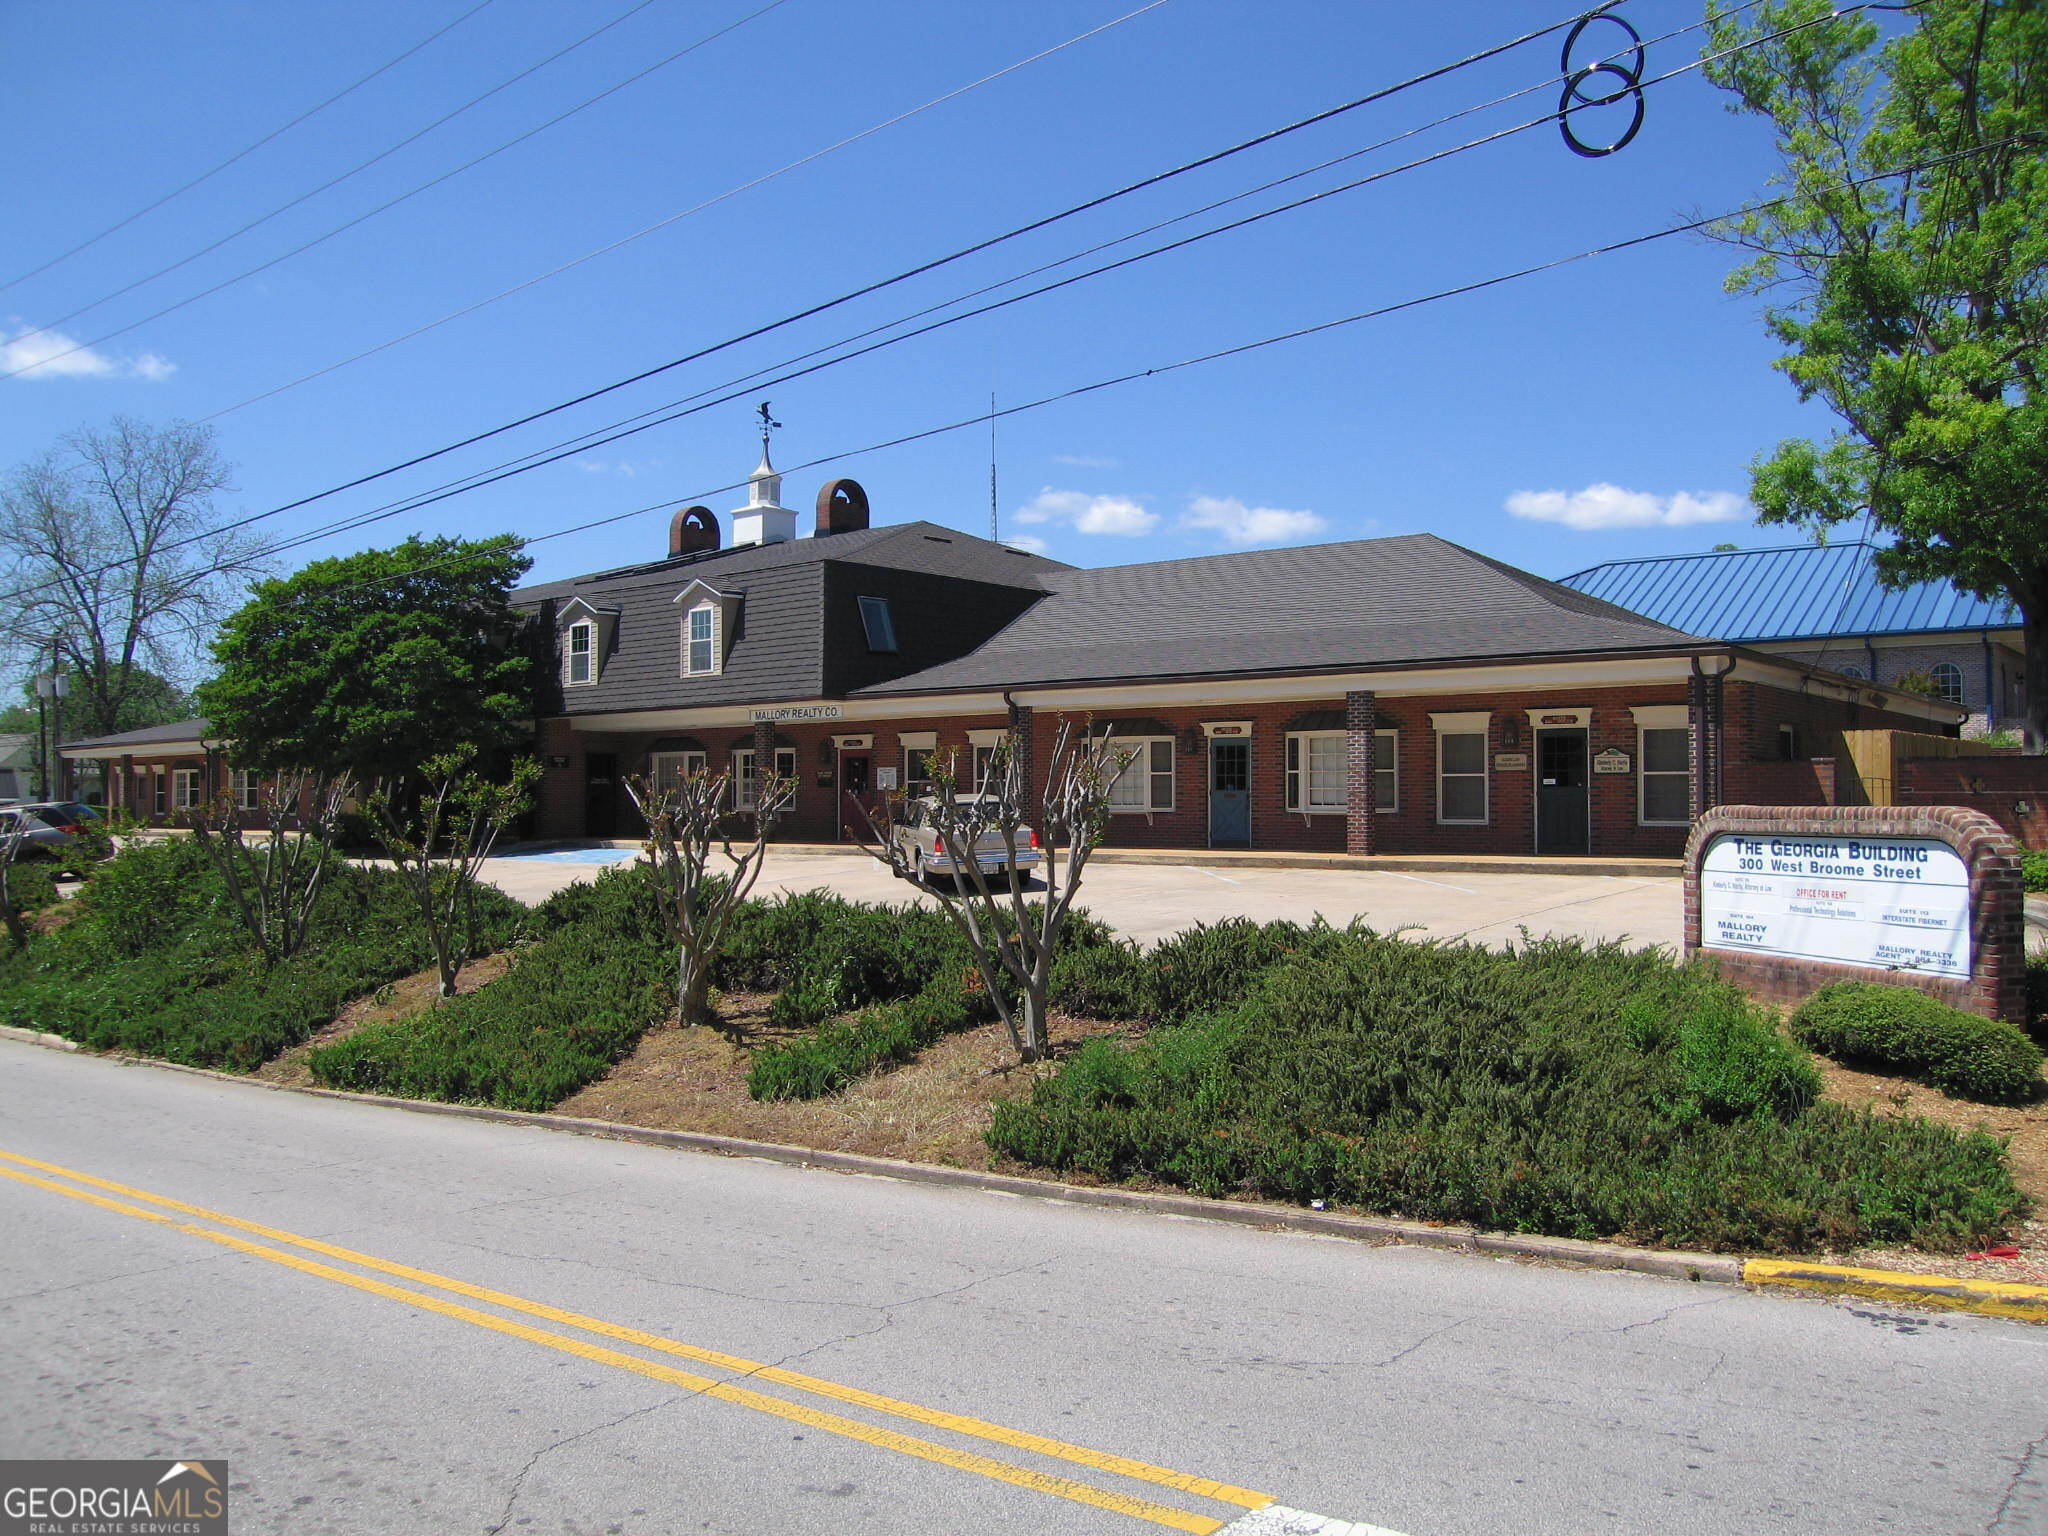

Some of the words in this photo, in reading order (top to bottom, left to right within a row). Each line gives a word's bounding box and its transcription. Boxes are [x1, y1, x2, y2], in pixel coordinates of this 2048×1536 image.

[755, 709, 790, 720] MALLORY
[792, 707, 823, 718] REALTY
[825, 707, 839, 717] CO.
[1734, 838, 1763, 855] THE
[1770, 839, 1840, 859] GEORGIA
[1848, 841, 1928, 862] BUILDING
[1739, 858, 1763, 870] 300
[1771, 859, 1802, 873] West
[1810, 861, 1864, 876] Broome
[1873, 863, 1921, 879] Street
[1796, 888, 1816, 898] OFFICE
[1818, 889, 1829, 899] FOR
[1831, 890, 1847, 899] RENT
[1882, 914, 1916, 923] INTERSTATE
[1718, 921, 1767, 932] MALLORY
[1721, 931, 1763, 943] REALTY
[1875, 951, 1901, 960] AGENT
[1878, 945, 1916, 955] MALLORY
[1920, 949, 1953, 959] REALTY
